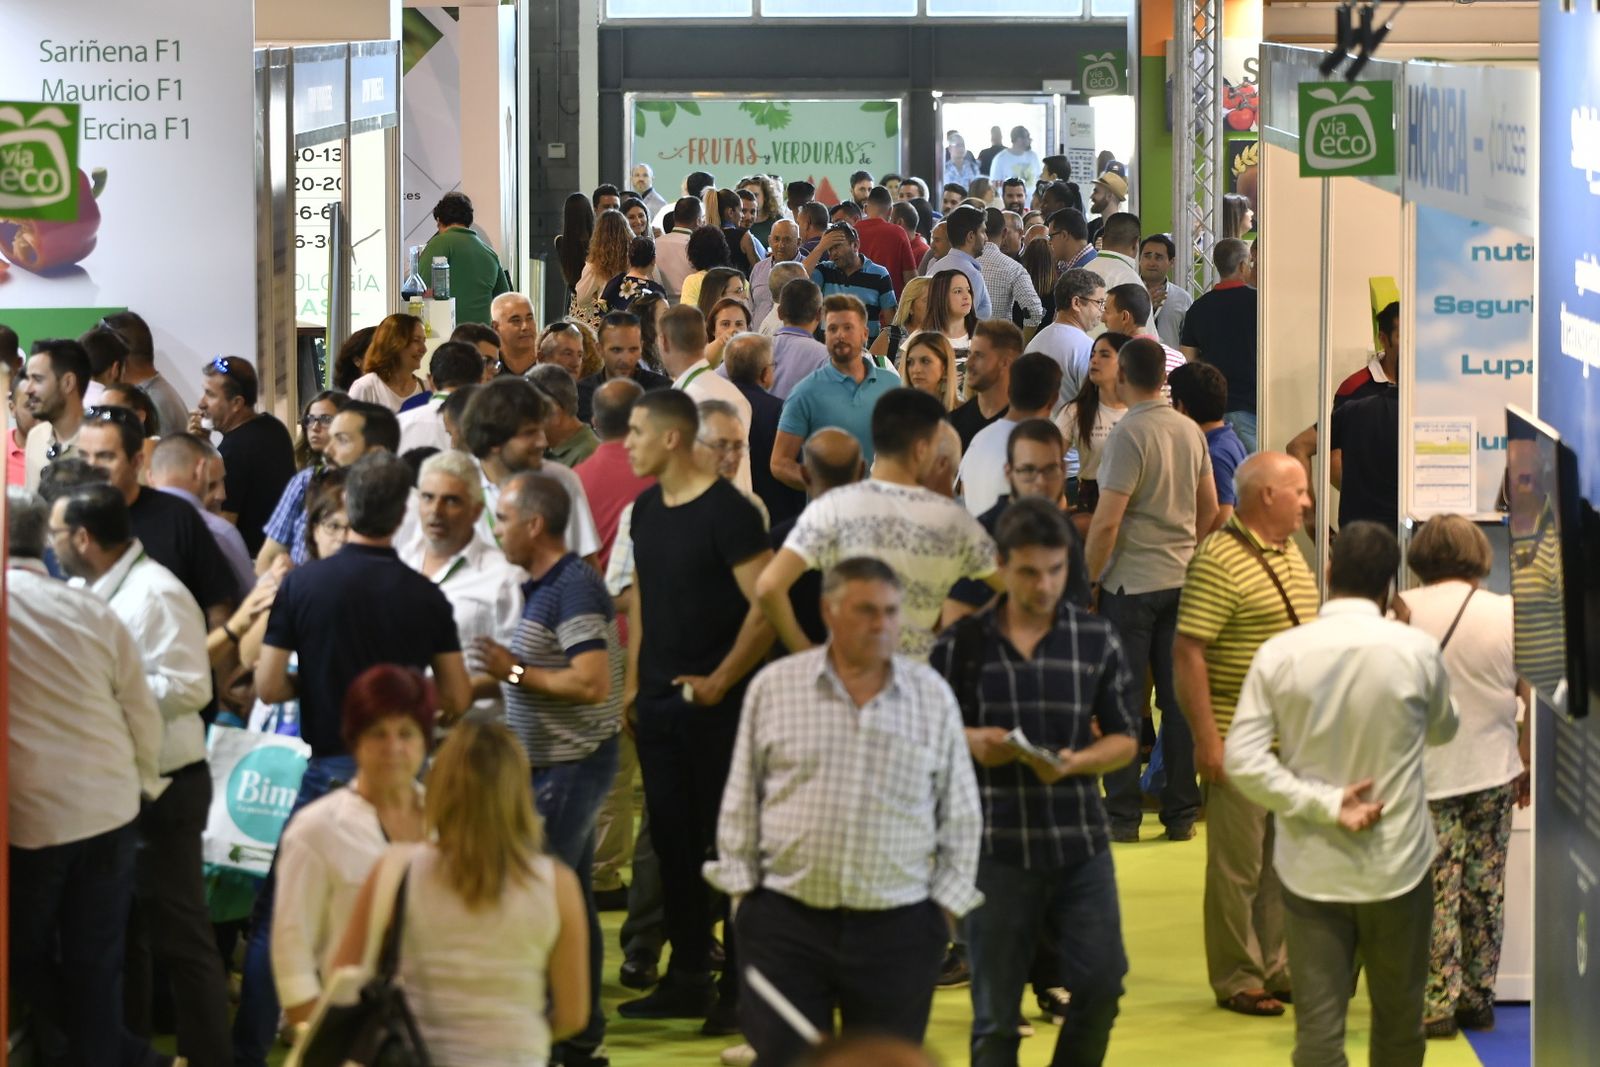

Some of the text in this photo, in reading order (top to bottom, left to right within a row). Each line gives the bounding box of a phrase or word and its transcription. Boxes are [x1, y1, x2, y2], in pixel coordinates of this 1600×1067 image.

[40, 39, 181, 63] Sariñena F1
[1090, 68, 1103, 78] vía
[1090, 78, 1114, 88] eco
[42, 78, 182, 102] Mauricio F1
[84, 117, 189, 140] Ercina F1
[1320, 116, 1347, 136] vía
[1320, 134, 1367, 155] eco
[1407, 82, 1469, 195] HORIBA
[3, 144, 34, 167] vía
[688, 137, 758, 165] FRUTAS
[772, 140, 855, 164] VERDURAS
[859, 152, 873, 164] de
[1, 166, 59, 193] eco
[403, 192, 421, 201] es
[296, 235, 331, 248] 6-3
